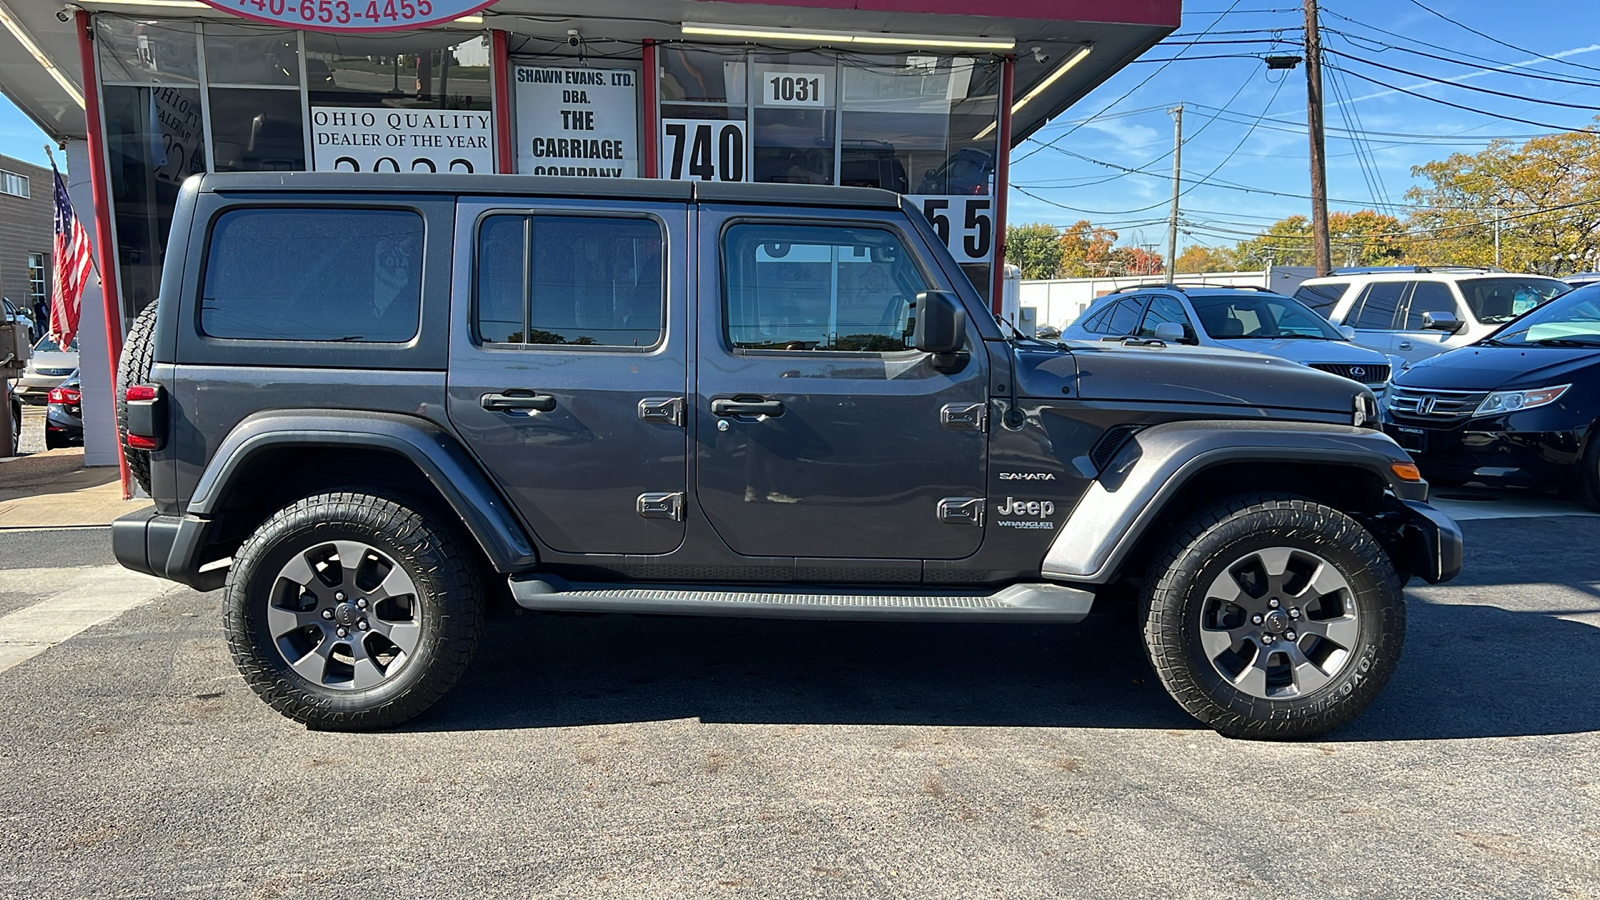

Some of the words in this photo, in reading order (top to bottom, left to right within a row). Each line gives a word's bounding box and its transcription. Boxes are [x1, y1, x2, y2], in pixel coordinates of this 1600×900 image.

[517, 68, 563, 84] SHAWN
[565, 71, 606, 85] EVANS.
[611, 73, 634, 87] LTD.
[562, 90, 591, 104] DBA.
[770, 76, 819, 101] 1031
[314, 112, 375, 126] OHIO
[387, 113, 489, 130] QUALITY
[560, 110, 594, 130] THE
[317, 132, 382, 146] DEALER
[385, 134, 406, 147] OF
[410, 135, 443, 148] THE
[446, 136, 488, 149] YEAR
[532, 137, 623, 159] CARRIAGE
[665, 123, 743, 182] 740
[999, 472, 1056, 480] SAHARA
[997, 496, 1055, 519] Jeep
[997, 520, 1054, 528] WRANGLER
[1340, 644, 1378, 698] TOYO
